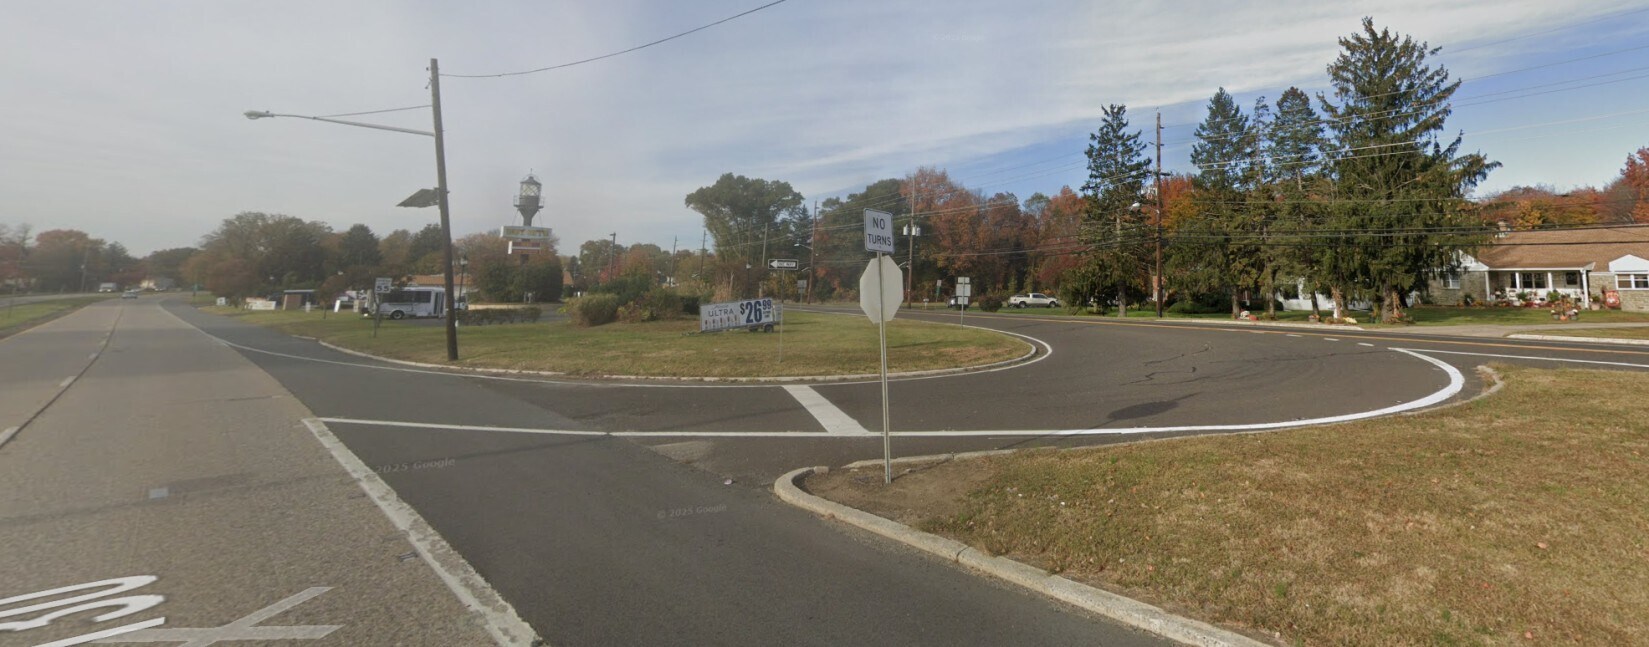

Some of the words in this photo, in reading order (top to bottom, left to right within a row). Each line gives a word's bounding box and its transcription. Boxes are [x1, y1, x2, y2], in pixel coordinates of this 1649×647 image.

[872, 216, 886, 230] NO
[867, 233, 892, 247] TURNS
[708, 308, 735, 317] ULTRA
